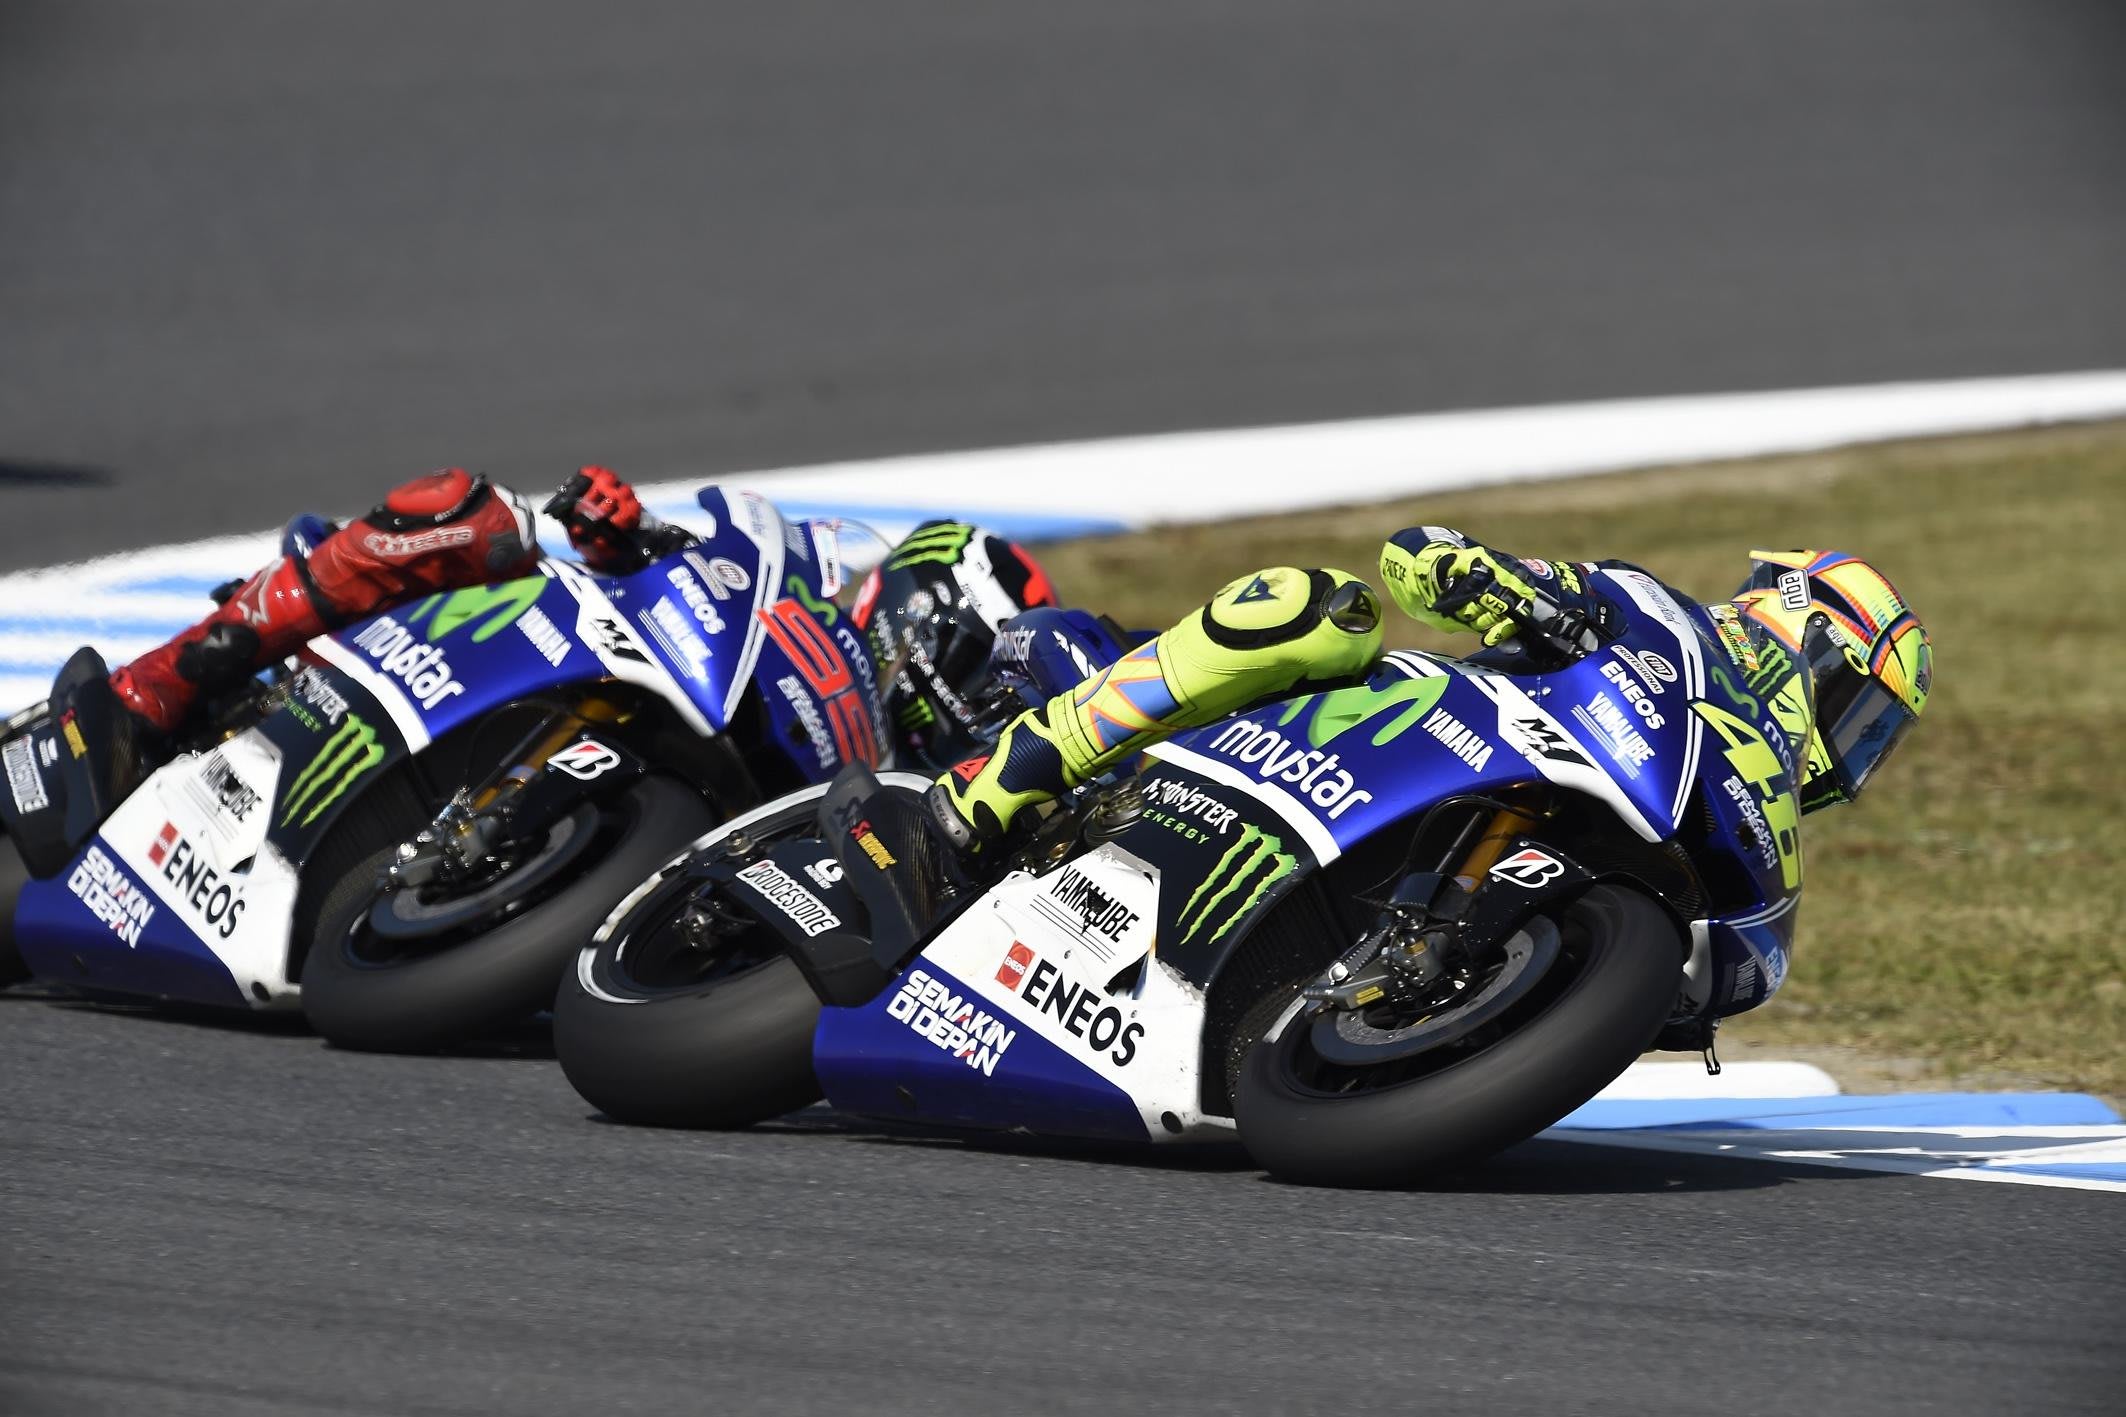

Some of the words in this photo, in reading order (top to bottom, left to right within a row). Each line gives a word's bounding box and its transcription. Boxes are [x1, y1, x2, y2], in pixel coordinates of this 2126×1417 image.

[1599, 660, 1666, 731] ENEOS
[1643, 654, 1674, 677] FIAT
[1421, 707, 1495, 773] YAMAHA
[1141, 777, 1240, 835] MONSTER
[1142, 807, 1211, 846] ENERGY
[1691, 700, 1800, 890] 46
[163, 838, 245, 940] ENEOS
[739, 861, 839, 935] BRIDGESTONE
[886, 990, 920, 1025] DI
[910, 1006, 1001, 1077] DEPAN
[901, 969, 1017, 1055] SEMAKIN
[1021, 957, 1145, 1067] ENEOS
